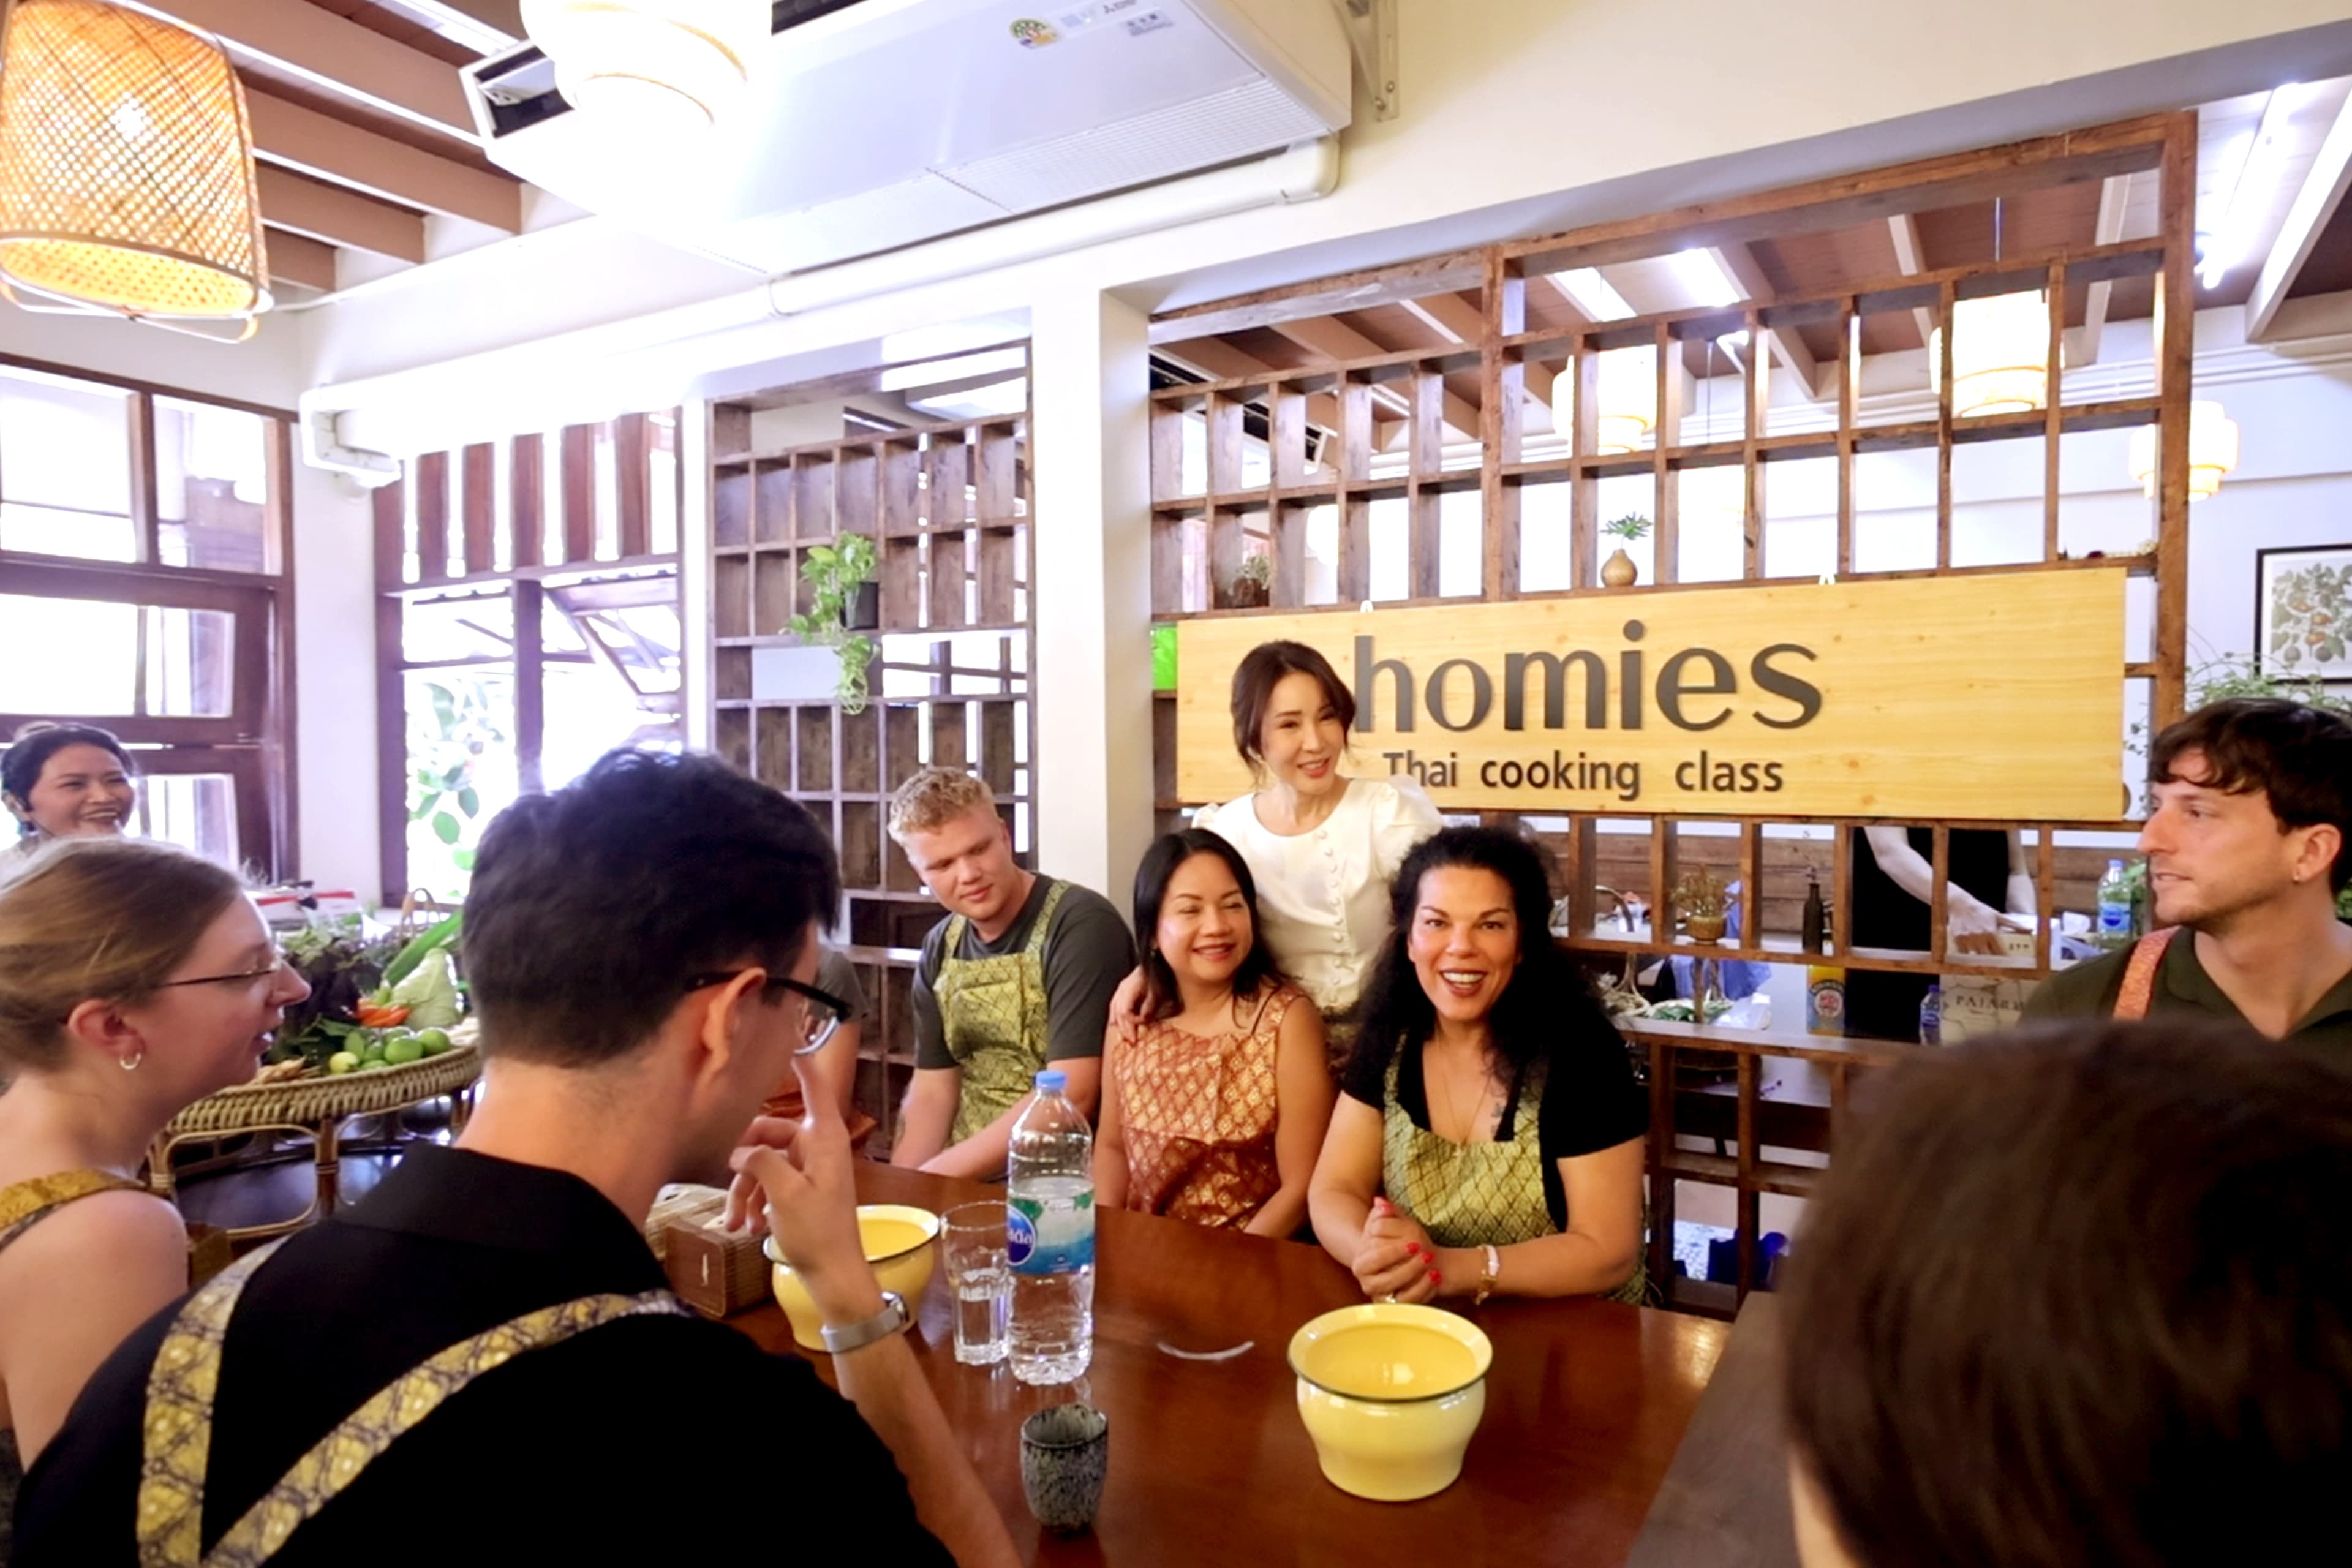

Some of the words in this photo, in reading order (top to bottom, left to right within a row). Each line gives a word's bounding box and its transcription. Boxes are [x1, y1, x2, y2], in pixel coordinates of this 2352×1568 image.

[1354, 619, 1823, 733] homies
[1382, 750, 1458, 788] Thai
[1480, 750, 1640, 802] cooking
[1675, 750, 1784, 793] class
